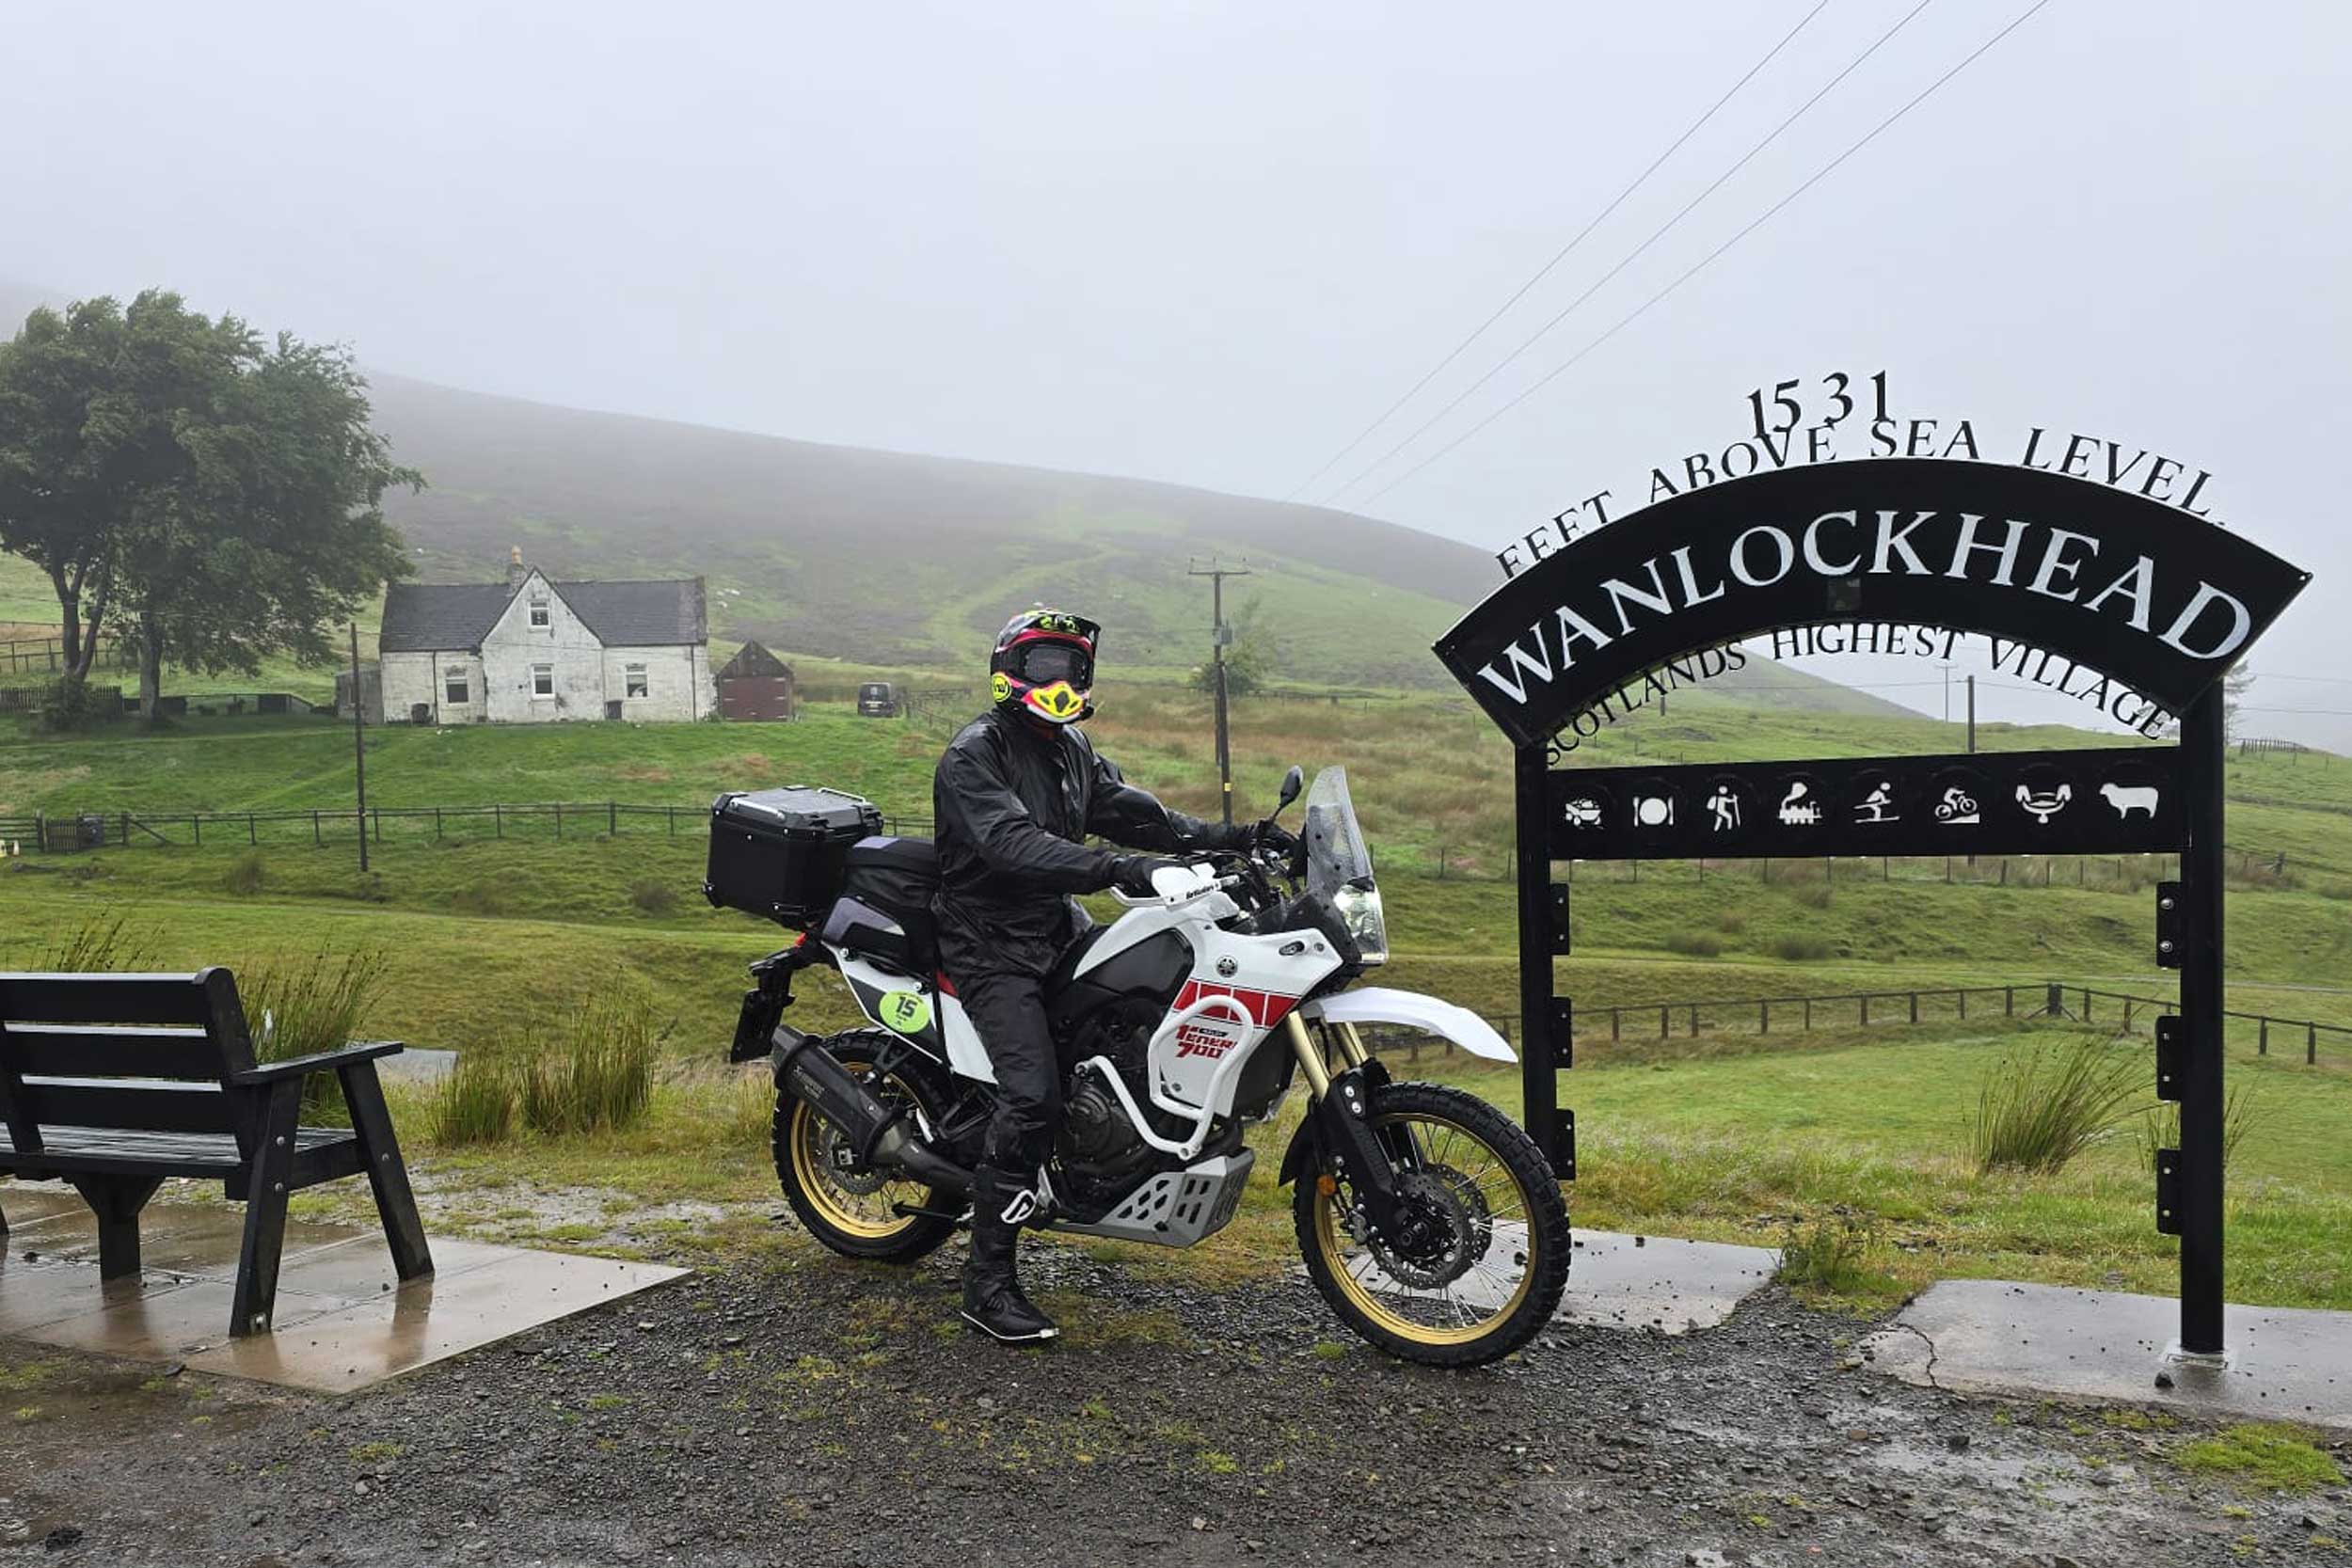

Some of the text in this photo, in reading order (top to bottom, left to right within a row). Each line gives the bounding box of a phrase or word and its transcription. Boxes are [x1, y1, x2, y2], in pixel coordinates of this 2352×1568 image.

[1747, 370, 1892, 438] 1531
[1496, 420, 2212, 579] FEET ABOVE SEA LEVEL
[1477, 509, 2251, 705] WANLOCKHEAD
[1546, 625, 2173, 767] SCOTLANDS HIGHEST VILLAGE
[897, 996, 918, 1018] 15
[1176, 1041, 1223, 1058] 700
